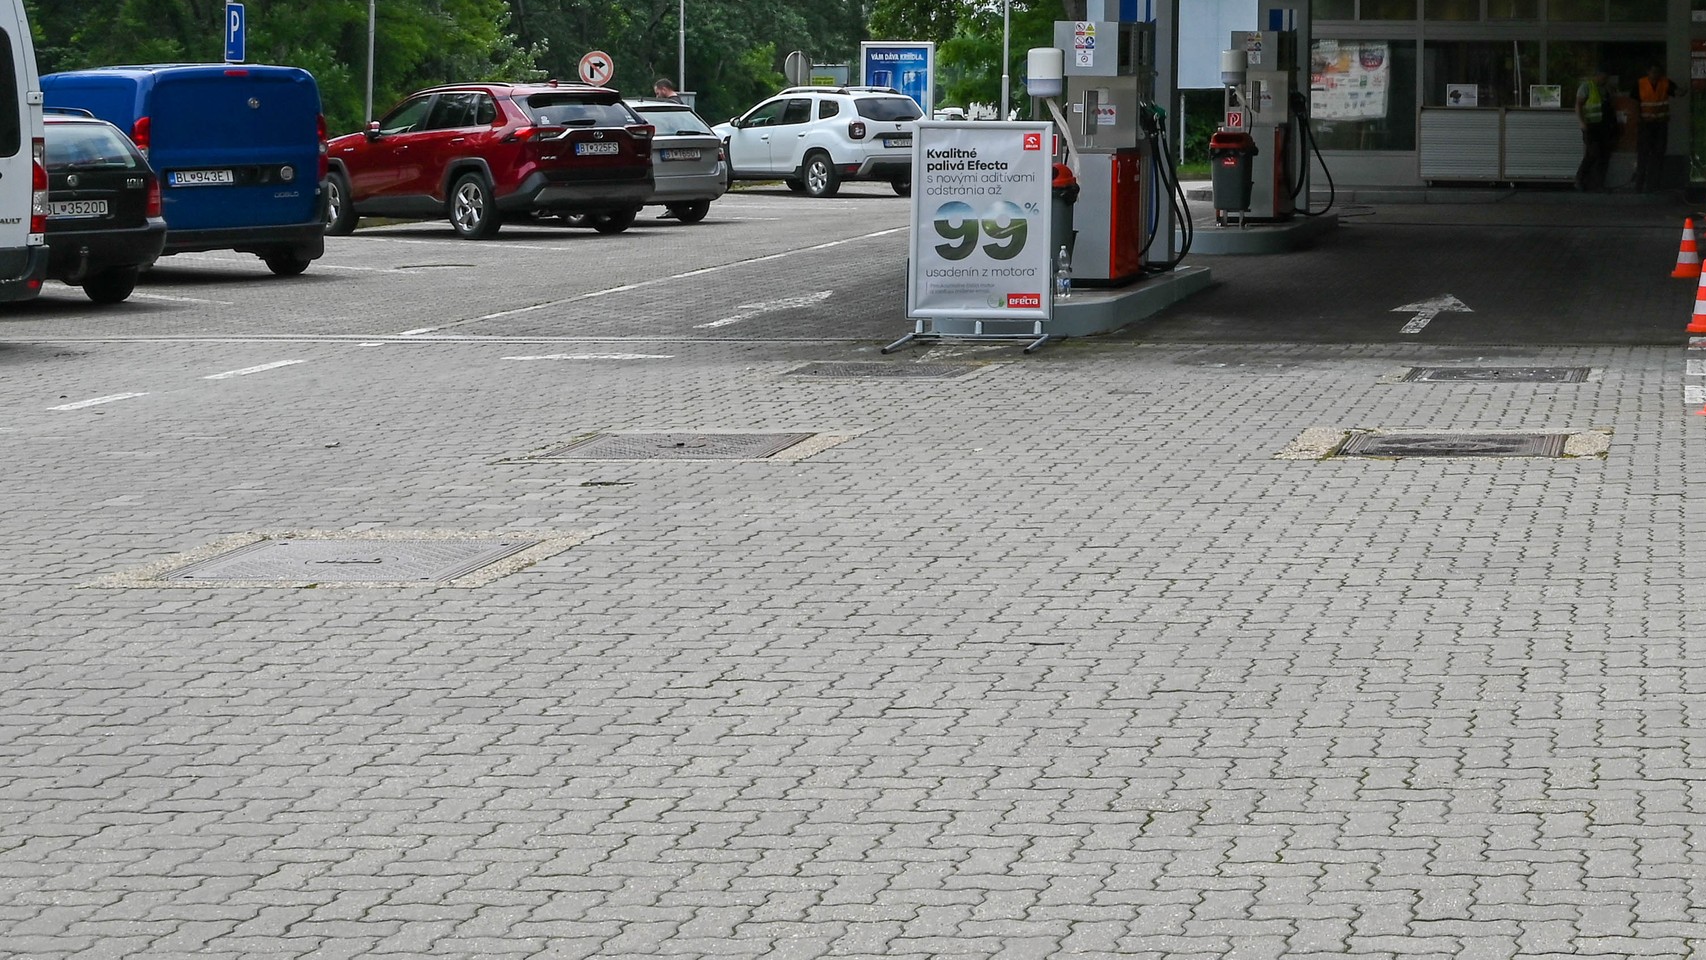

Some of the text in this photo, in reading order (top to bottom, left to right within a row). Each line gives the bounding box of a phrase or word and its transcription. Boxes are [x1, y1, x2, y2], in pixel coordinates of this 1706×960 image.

[230, 10, 240, 43] P
[927, 148, 977, 159] Kvalitné
[927, 160, 1008, 173] palivá Efecta
[176, 170, 230, 183] BL 943EI
[927, 175, 933, 183] s
[936, 172, 978, 184] novými
[927, 185, 1002, 196] odstránia až
[926, 267, 979, 278] usadenín
[982, 269, 988, 277] z
[1009, 295, 1038, 305] efecta
